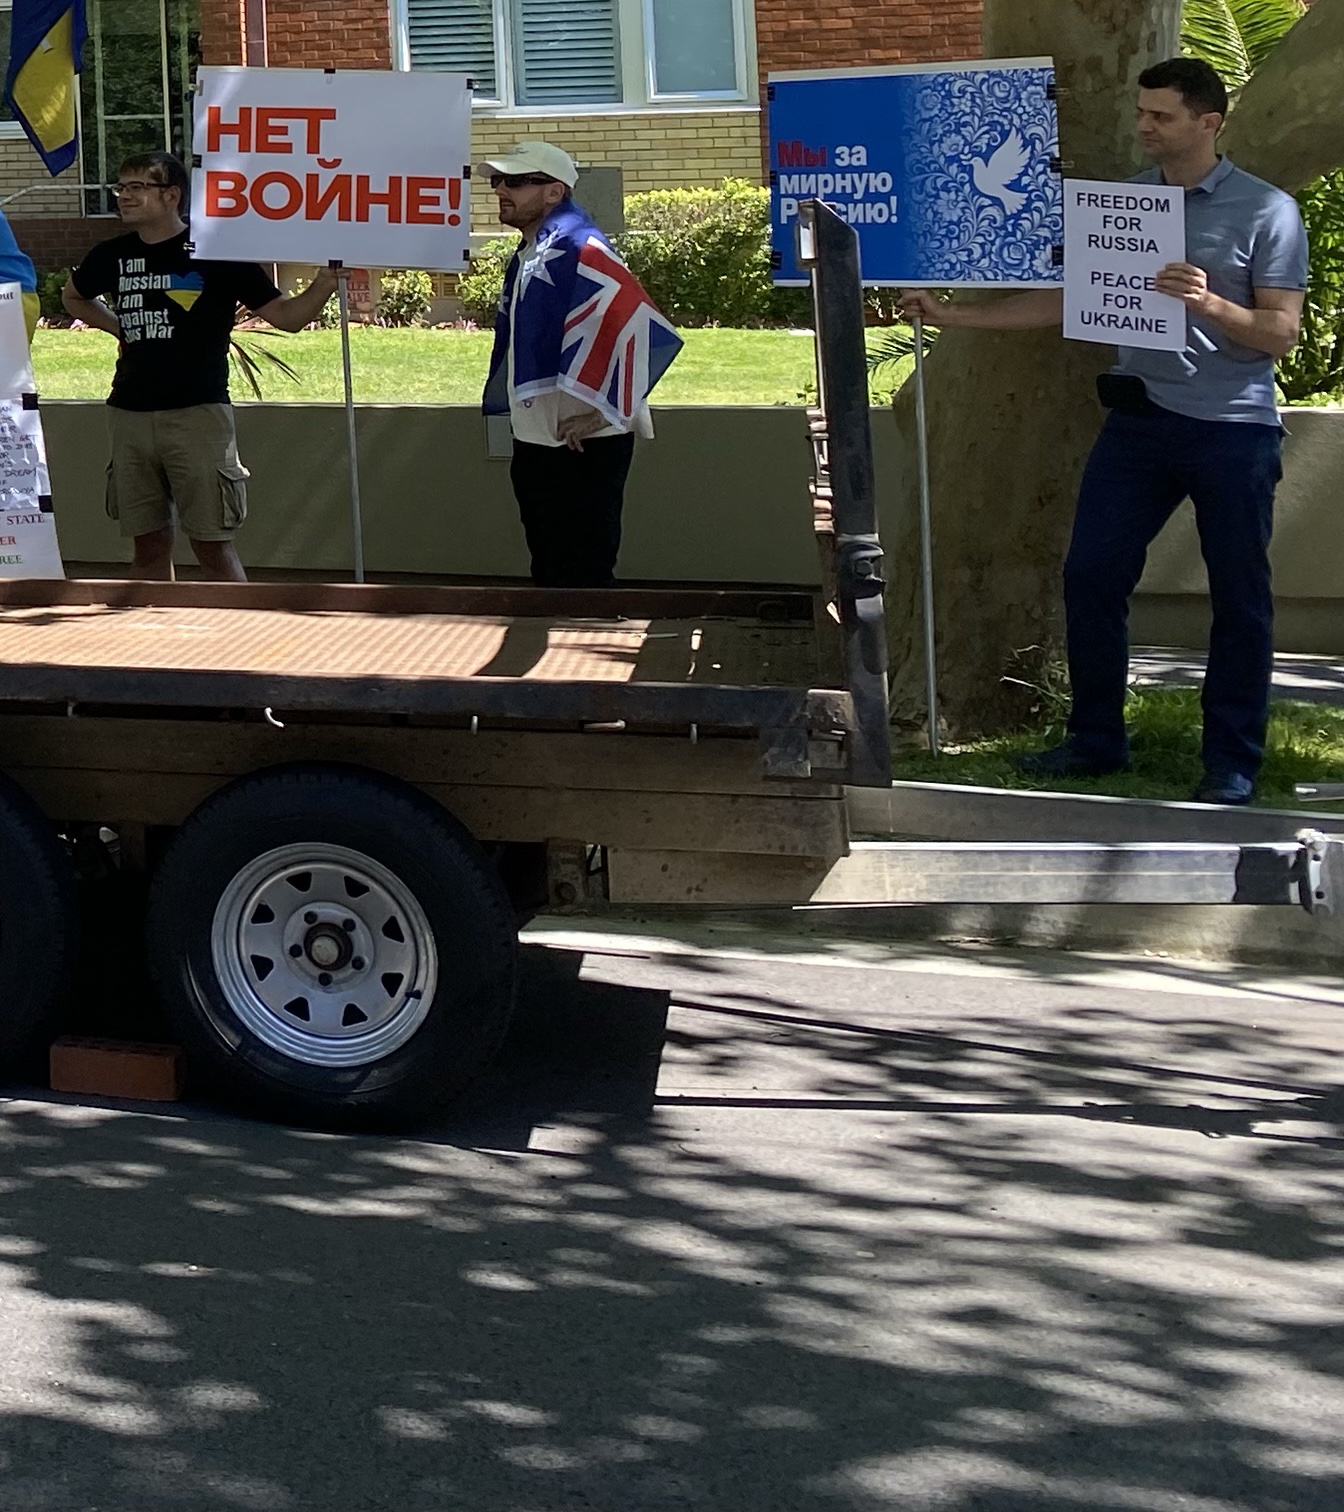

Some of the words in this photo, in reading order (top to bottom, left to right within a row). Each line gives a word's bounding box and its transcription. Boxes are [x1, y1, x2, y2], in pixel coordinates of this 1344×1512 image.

[206, 106, 337, 155] НЕТ
[777, 140, 827, 168] Мы
[834, 145, 867, 167] за
[205, 157, 461, 227] ВОЙНЕ!
[779, 172, 893, 200] мирную
[780, 195, 898, 225] Рсию!
[1076, 192, 1171, 213] FREEDOM
[1102, 214, 1143, 232] FOR
[1088, 233, 1160, 254] RUSSIA
[117, 257, 124, 275] I
[125, 257, 146, 273] am
[118, 272, 172, 293] Russian
[1090, 271, 1157, 292] PEACE
[121, 293, 144, 309] am
[1102, 293, 1143, 311] FOR
[145, 323, 175, 339] War
[1080, 310, 1168, 334] UKRAINE
[6, 513, 46, 526] STATE
